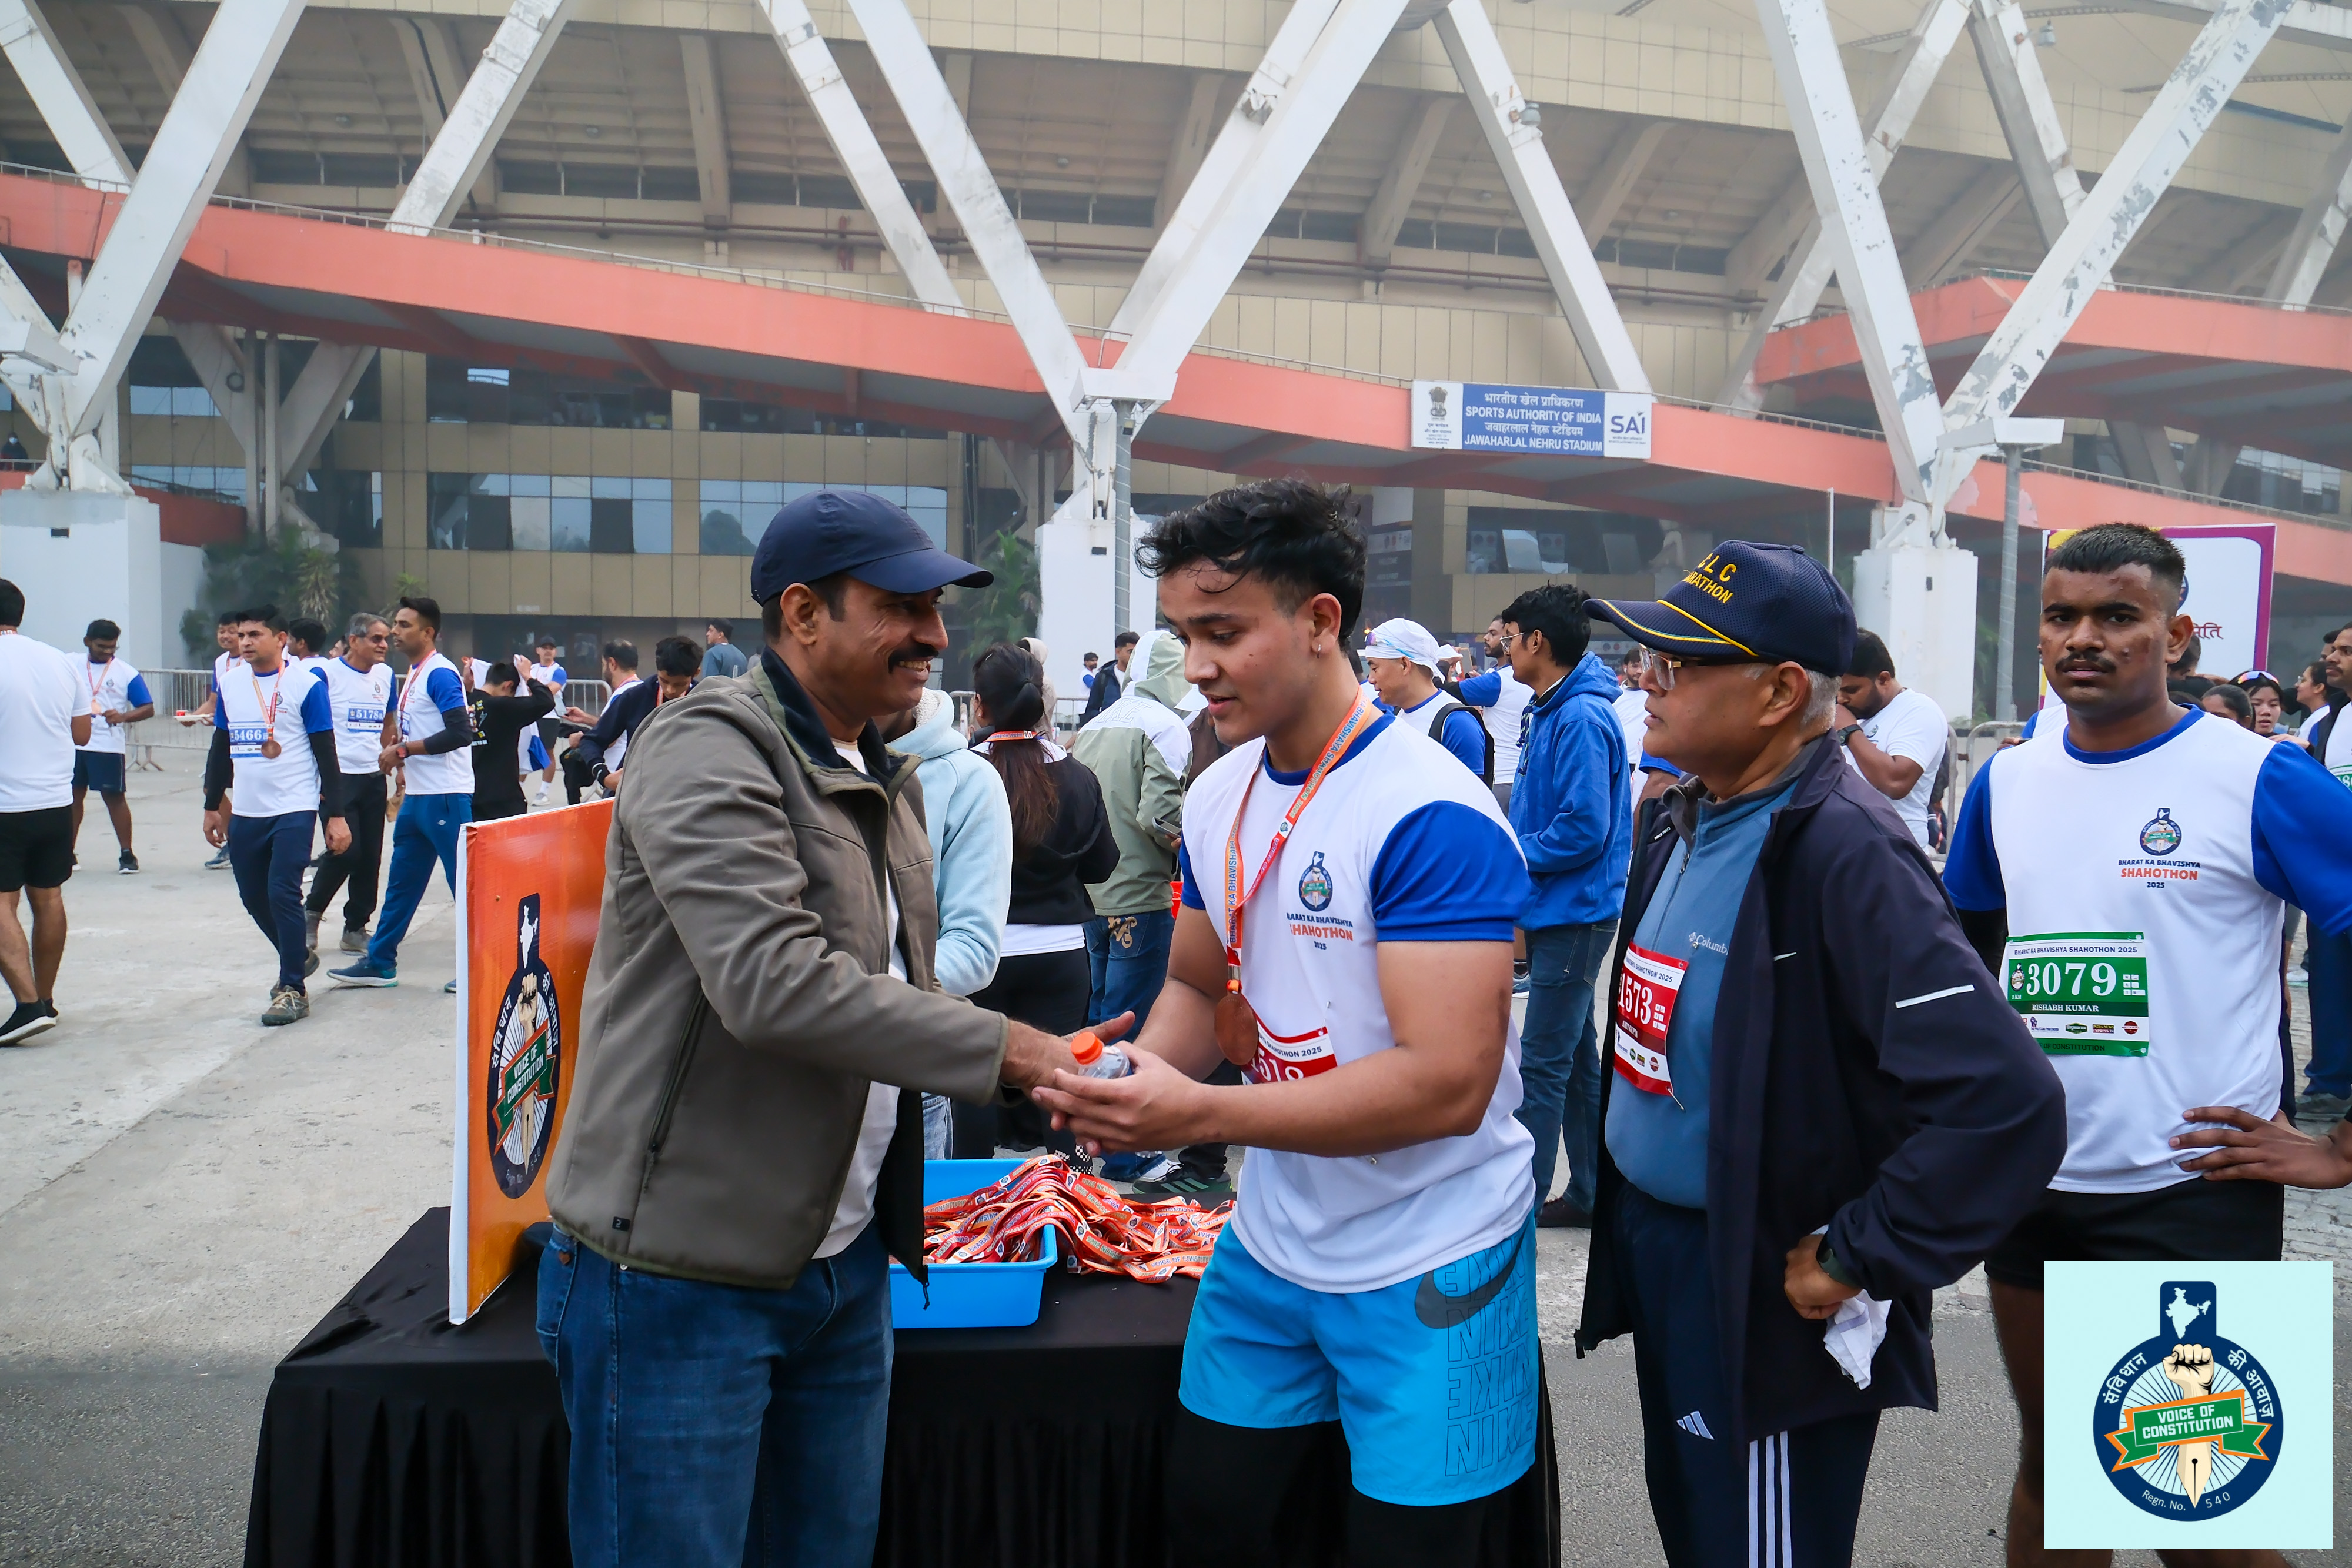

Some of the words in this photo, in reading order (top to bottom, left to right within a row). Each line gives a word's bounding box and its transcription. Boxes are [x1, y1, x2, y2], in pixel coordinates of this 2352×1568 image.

[1484, 390, 1518, 404] भारतीय
[1519, 392, 1539, 406] खेल
[1541, 393, 1585, 408] प्राधिकरण
[1465, 406, 1505, 419] SPORTS
[1506, 408, 1561, 421] AUTHORITY
[1562, 412, 1575, 422] OF
[1576, 412, 1602, 424] INDIA
[1484, 422, 1529, 433] जवाहरलाल
[1531, 421, 1550, 436] नेहरू
[1552, 422, 1583, 436] स्टेडियम
[1611, 415, 1645, 434] SAI
[1465, 434, 1528, 448] JAWAHARLAL
[1529, 437, 1561, 449] NEHRU
[1563, 439, 1602, 452] STADIUM
[356, 709, 379, 720] 5178
[235, 729, 262, 741] 5466
[1330, 707, 1364, 752] BHAVISHAYA
[1228, 841, 1237, 891] BHAVISHAYA
[2157, 860, 2201, 868] BHAVISHYA
[2121, 868, 2198, 880] SHAHOTHON
[1228, 893, 1235, 905] KA
[1316, 917, 1354, 928] BHAVISHYA
[1314, 941, 1327, 950] 2025
[1658, 973, 1673, 983] 2025
[2026, 962, 2117, 996] 3079
[1619, 972, 1653, 1025] 1573
[2065, 1004, 2099, 1012] KUMAR
[1302, 1046, 1322, 1057] 2025
[514, 1051, 529, 1079] VOICE
[530, 1044, 537, 1058] OF
[507, 1053, 544, 1104] CONSTITUTION
[968, 1233, 991, 1252] BHARAT
[1151, 1258, 1170, 1268] VOICE
[1446, 1281, 1529, 1363] NIKE
[1445, 1389, 1533, 1477] NIKE
